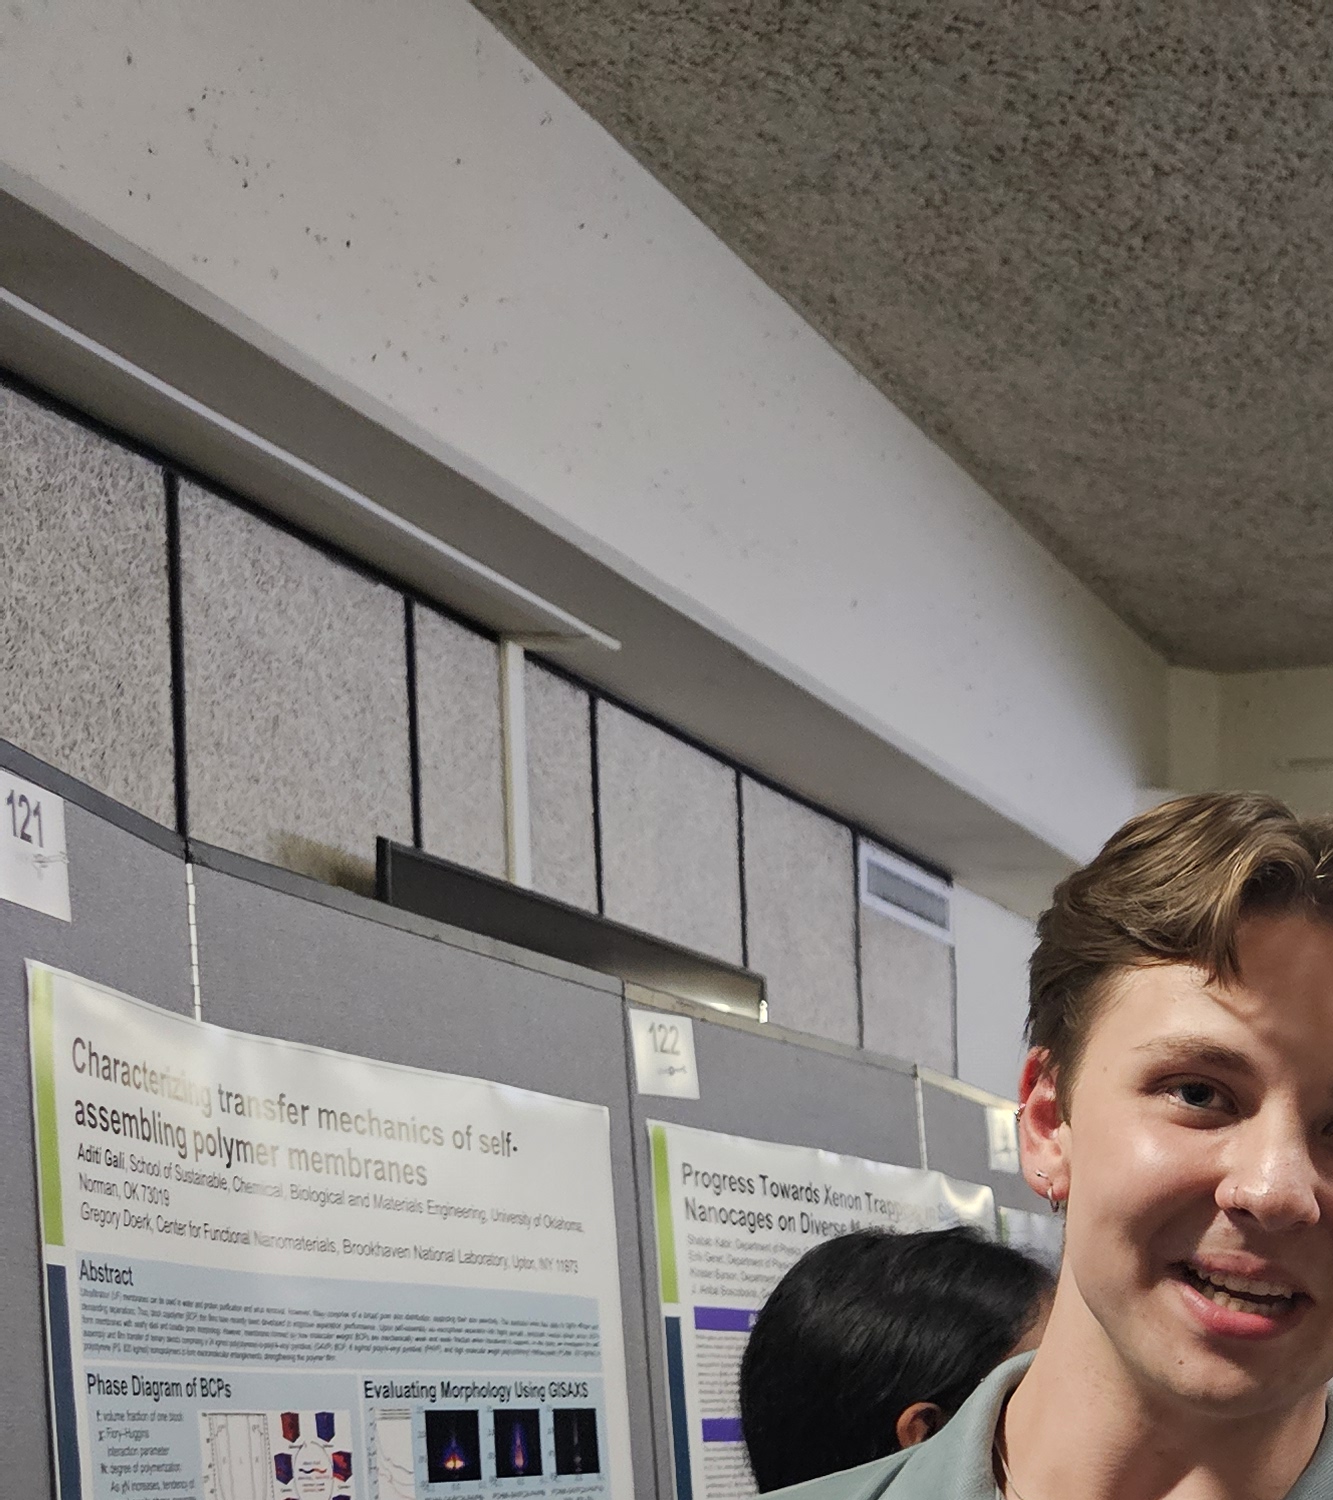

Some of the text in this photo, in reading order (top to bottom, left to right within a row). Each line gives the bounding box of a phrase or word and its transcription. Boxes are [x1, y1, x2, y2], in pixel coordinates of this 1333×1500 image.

[6, 788, 44, 848] 121
[648, 1021, 682, 1056] 122
[72, 1036, 212, 1118] Characterizing
[217, 1083, 310, 1125] transfer
[317, 1105, 445, 1147] mechanics
[452, 1124, 473, 1150] of
[74, 1098, 429, 1187] assembling polymer membranes
[77, 1142, 102, 1165] Aditi
[129, 1153, 161, 1178] School
[163, 1162, 173, 1180] of
[175, 1163, 230, 1194] Sustainable,
[289, 1183, 345, 1208] Biological
[347, 1192, 370, 1208] and
[373, 1193, 424, 1214] Materials
[426, 1199, 488, 1225] Engineering,
[490, 1207, 531, 1230] University
[532, 1212, 542, 1227] of
[78, 1172, 121, 1199] Norman,
[123, 1180, 140, 1202] OK
[682, 1161, 755, 1197] Progress
[758, 1173, 820, 1205] Towards
[824, 1183, 862, 1211] Xenon
[80, 1201, 122, 1230] Gregory
[123, 1208, 154, 1234] Doerk,
[155, 1214, 188, 1237] Center
[188, 1220, 202, 1239] for
[203, 1222, 251, 1245] Functional
[253, 1229, 339, 1257] Nanomaterials,
[341, 1238, 411, 1260] Brookhaven
[413, 1243, 457, 1263] National
[458, 1248, 510, 1271] Laboratory,
[684, 1195, 774, 1234] Nanocages
[777, 1213, 797, 1233] on
[800, 1210, 848, 1237] Diverse
[78, 1258, 135, 1287] Abstract
[86, 1372, 232, 1403] Phase Diagram of BCPs
[363, 1380, 589, 1403] Evaluating Morphology Using GISAXS
